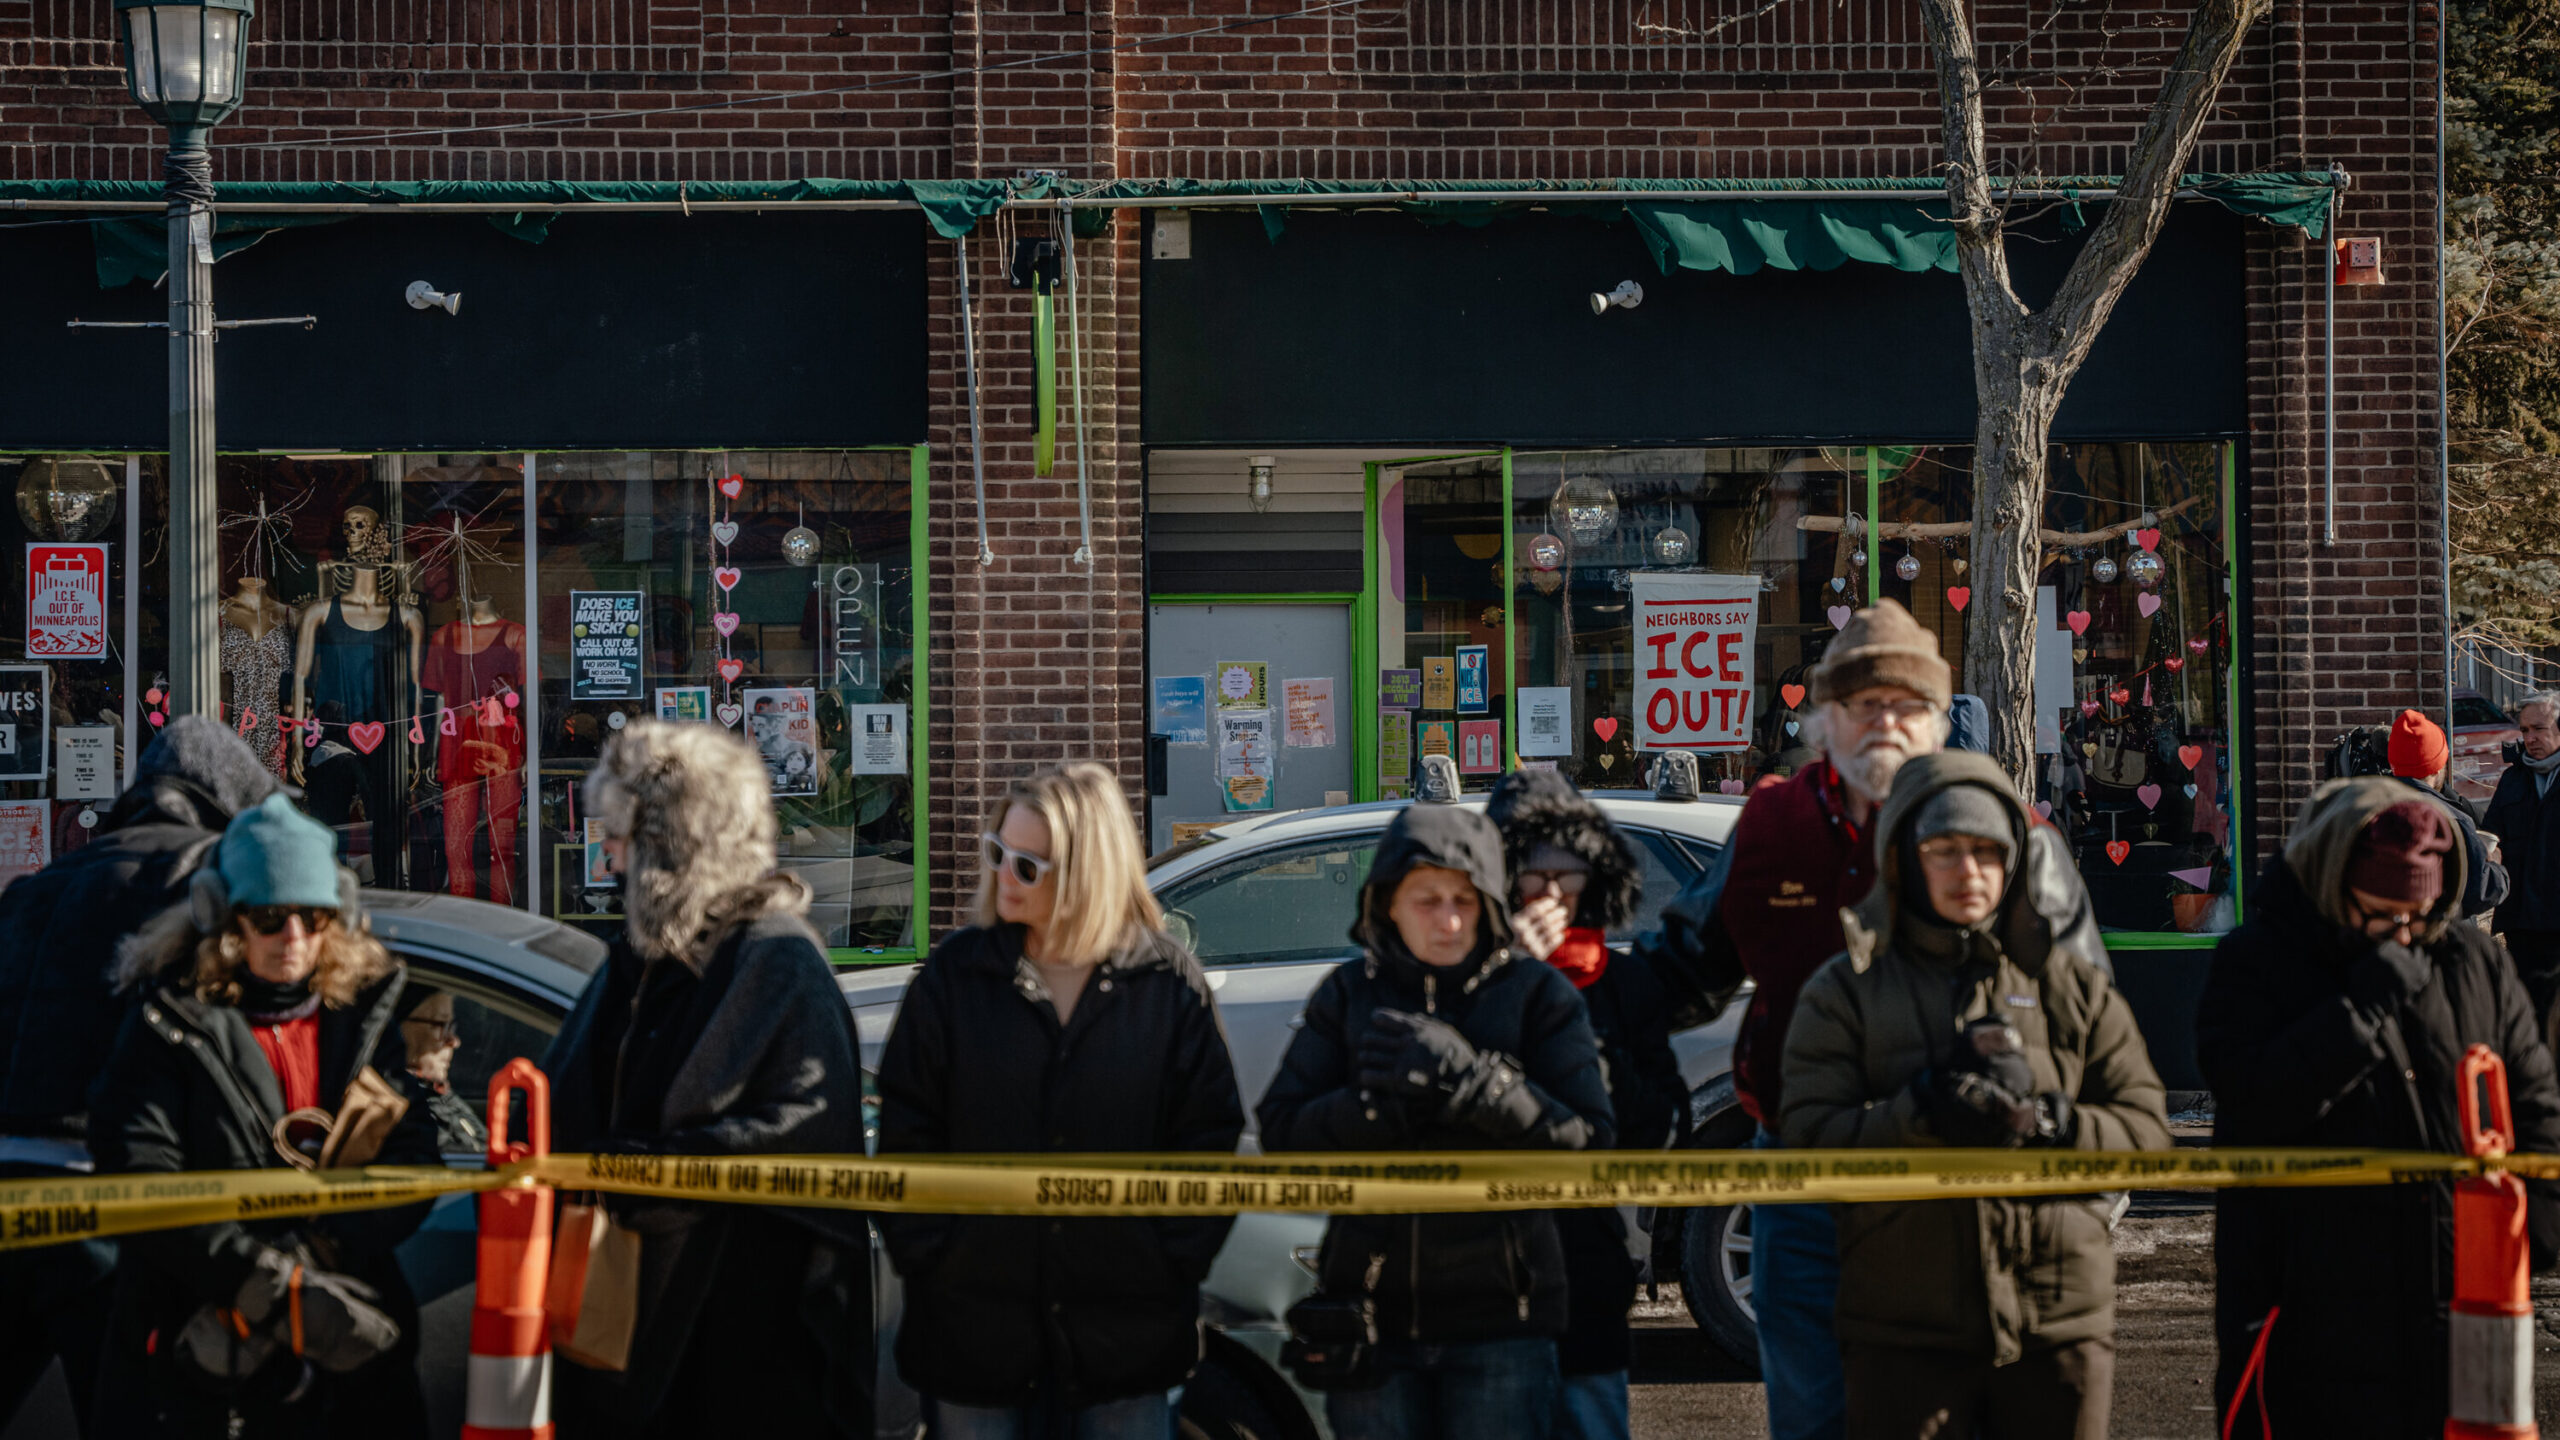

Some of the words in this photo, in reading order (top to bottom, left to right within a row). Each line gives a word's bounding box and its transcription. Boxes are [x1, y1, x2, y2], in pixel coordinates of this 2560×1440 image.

[55, 591, 78, 601] I.C.E.
[579, 598, 613, 610] DOES
[614, 598, 635, 610] ICE
[49, 603, 68, 614] OUT
[72, 603, 84, 613] OF
[575, 610, 612, 622] MAKE
[614, 610, 639, 622] YOU
[35, 616, 98, 625] MINNEAPOLIS
[589, 622, 626, 634] SICK?
[834, 566, 863, 686] OPEN
[1647, 612, 1722, 628] NEIGHBORS
[1726, 612, 1749, 624] SAY
[576, 648, 603, 656] WORK
[604, 648, 618, 656] ON
[619, 648, 637, 656] 1/23
[580, 639, 602, 647] CALL
[603, 639, 620, 647] OUT
[622, 639, 634, 647] OF
[1647, 631, 1744, 682] ICE
[1461, 688, 1482, 704] ICE
[1646, 688, 1750, 737] OUT!
[789, 719, 808, 730] KID
[1225, 720, 1262, 732] Warming
[672, 1160, 718, 1190] NOT
[726, 1164, 759, 1192] DO
[768, 1166, 819, 1197] LINE
[825, 1169, 906, 1202] POLICE
[1036, 1176, 1112, 1206] CROSS
[1121, 1178, 1168, 1206] NOT
[1178, 1180, 1208, 1206] DO
[1217, 1181, 1267, 1206] LINE
[1277, 1182, 1354, 1206] POLICE
